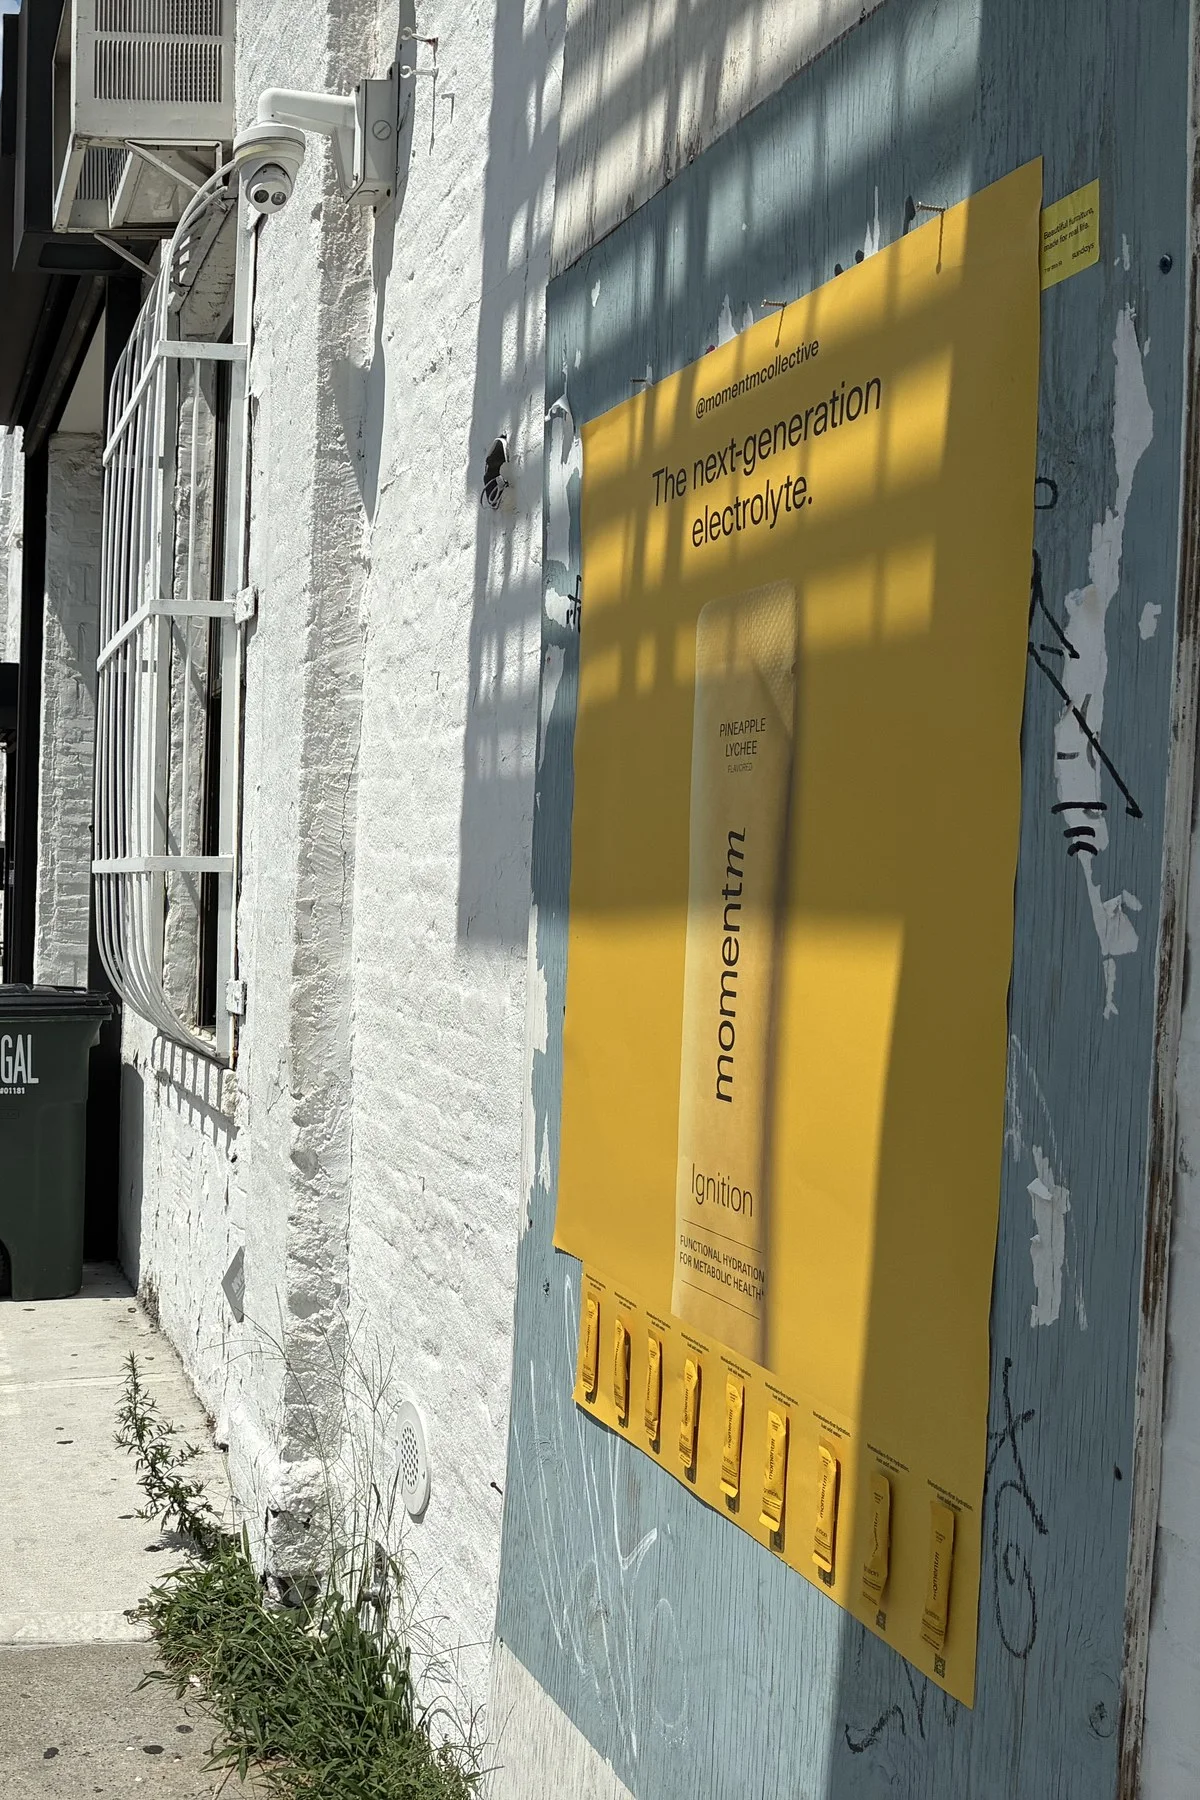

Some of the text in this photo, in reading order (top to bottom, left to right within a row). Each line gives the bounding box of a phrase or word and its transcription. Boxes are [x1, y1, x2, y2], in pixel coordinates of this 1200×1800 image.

[696, 340, 819, 419] @momentmcollective
[652, 377, 882, 507] The next-generation
[692, 475, 813, 547] electrolyte.
[720, 717, 766, 737] PINEAPPLE
[725, 740, 757, 757] LYCHEE
[727, 762, 753, 774] FLAVORED
[716, 827, 746, 1103] momentm
[1, 1034, 39, 1084] GAL
[0, 1087, 25, 1095] #01181
[692, 1163, 753, 1217] Ignition
[680, 1235, 765, 1283] FUNCTIONAL HYDRATION
[680, 1251, 692, 1268] FOR
[693, 1258, 732, 1287] METABOLIC
